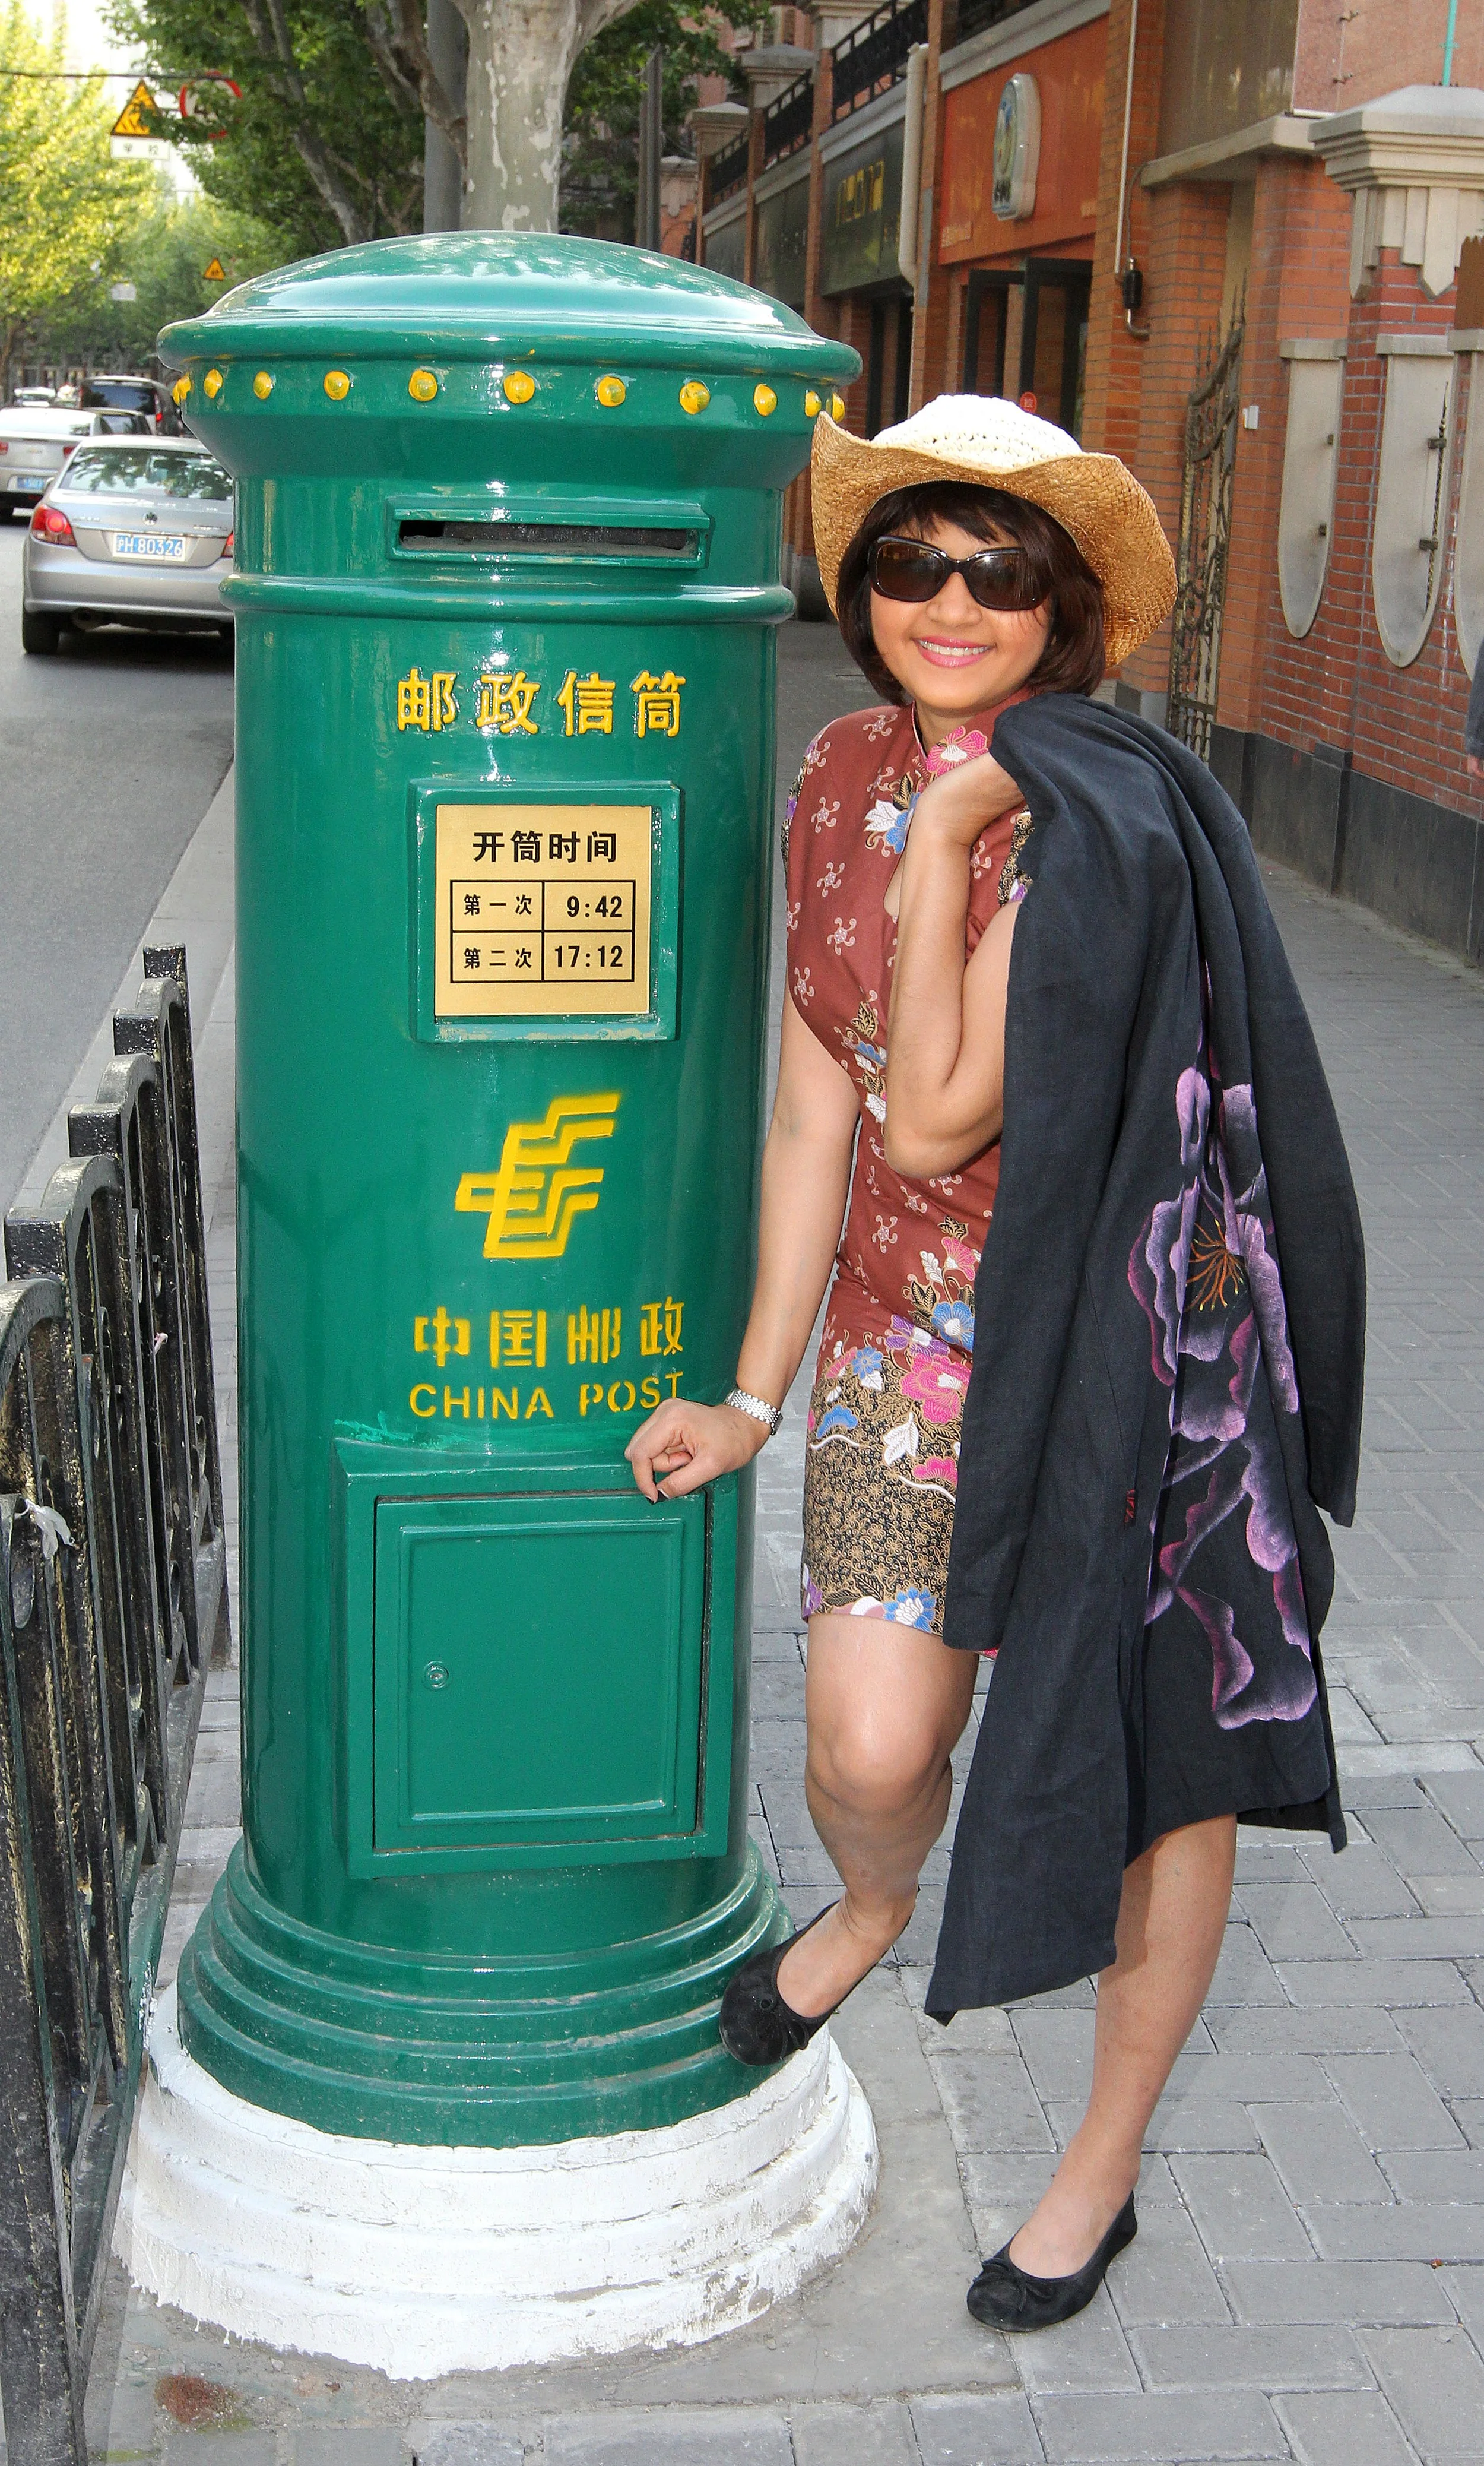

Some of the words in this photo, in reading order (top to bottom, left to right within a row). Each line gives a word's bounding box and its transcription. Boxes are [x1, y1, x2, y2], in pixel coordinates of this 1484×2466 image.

[397, 668, 686, 738] 邮政信筒
[473, 830, 617, 863] 开筒时间
[463, 894, 532, 916] 第一次
[566, 895, 623, 918] 9:42
[463, 947, 532, 969] 第二次
[554, 945, 623, 968] 17:12
[414, 1296, 685, 1368] 中国邮政
[409, 1382, 554, 1420] CHINA
[579, 1370, 684, 1417] POST
